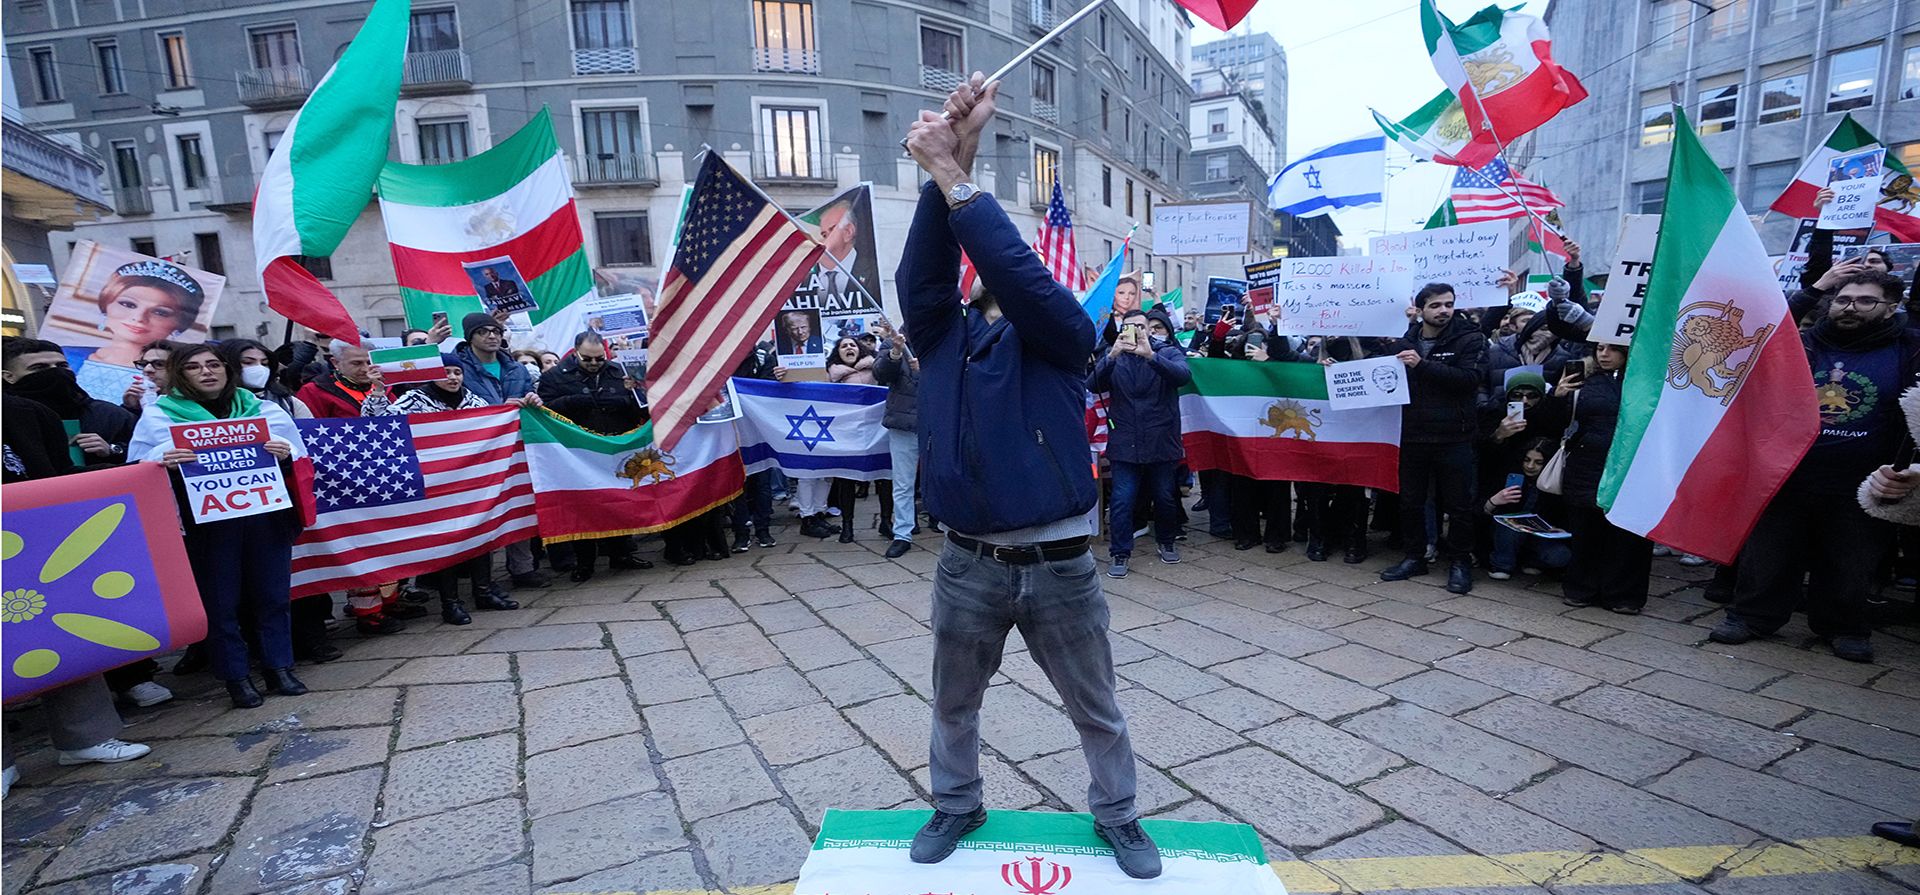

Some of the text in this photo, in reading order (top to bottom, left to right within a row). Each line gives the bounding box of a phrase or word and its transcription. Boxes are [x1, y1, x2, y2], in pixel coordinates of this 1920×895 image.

[1841, 183, 1866, 191] YOUR
[1837, 194, 1861, 204] B2s
[1155, 213, 1183, 223] Keep
[1823, 211, 1870, 220] WELCOME
[1170, 233, 1244, 249] President Trump
[1375, 237, 1407, 253] Blood
[1412, 235, 1434, 248] isn't
[1291, 262, 1333, 276] 12000
[1339, 259, 1373, 275] Killed
[1282, 280, 1306, 291] This
[1312, 282, 1323, 290] is
[1463, 279, 1480, 287] the
[1282, 298, 1301, 314] My
[1349, 370, 1362, 378] THE
[1333, 377, 1366, 385] MULLAHS
[1336, 385, 1364, 393] DESERVE
[182, 422, 260, 440] OBAMA
[190, 433, 256, 448] WATCHED
[197, 447, 258, 464] BIDEN
[204, 459, 256, 472] TALKED
[190, 472, 277, 493] YOU CAN
[200, 485, 283, 516] ACT.
